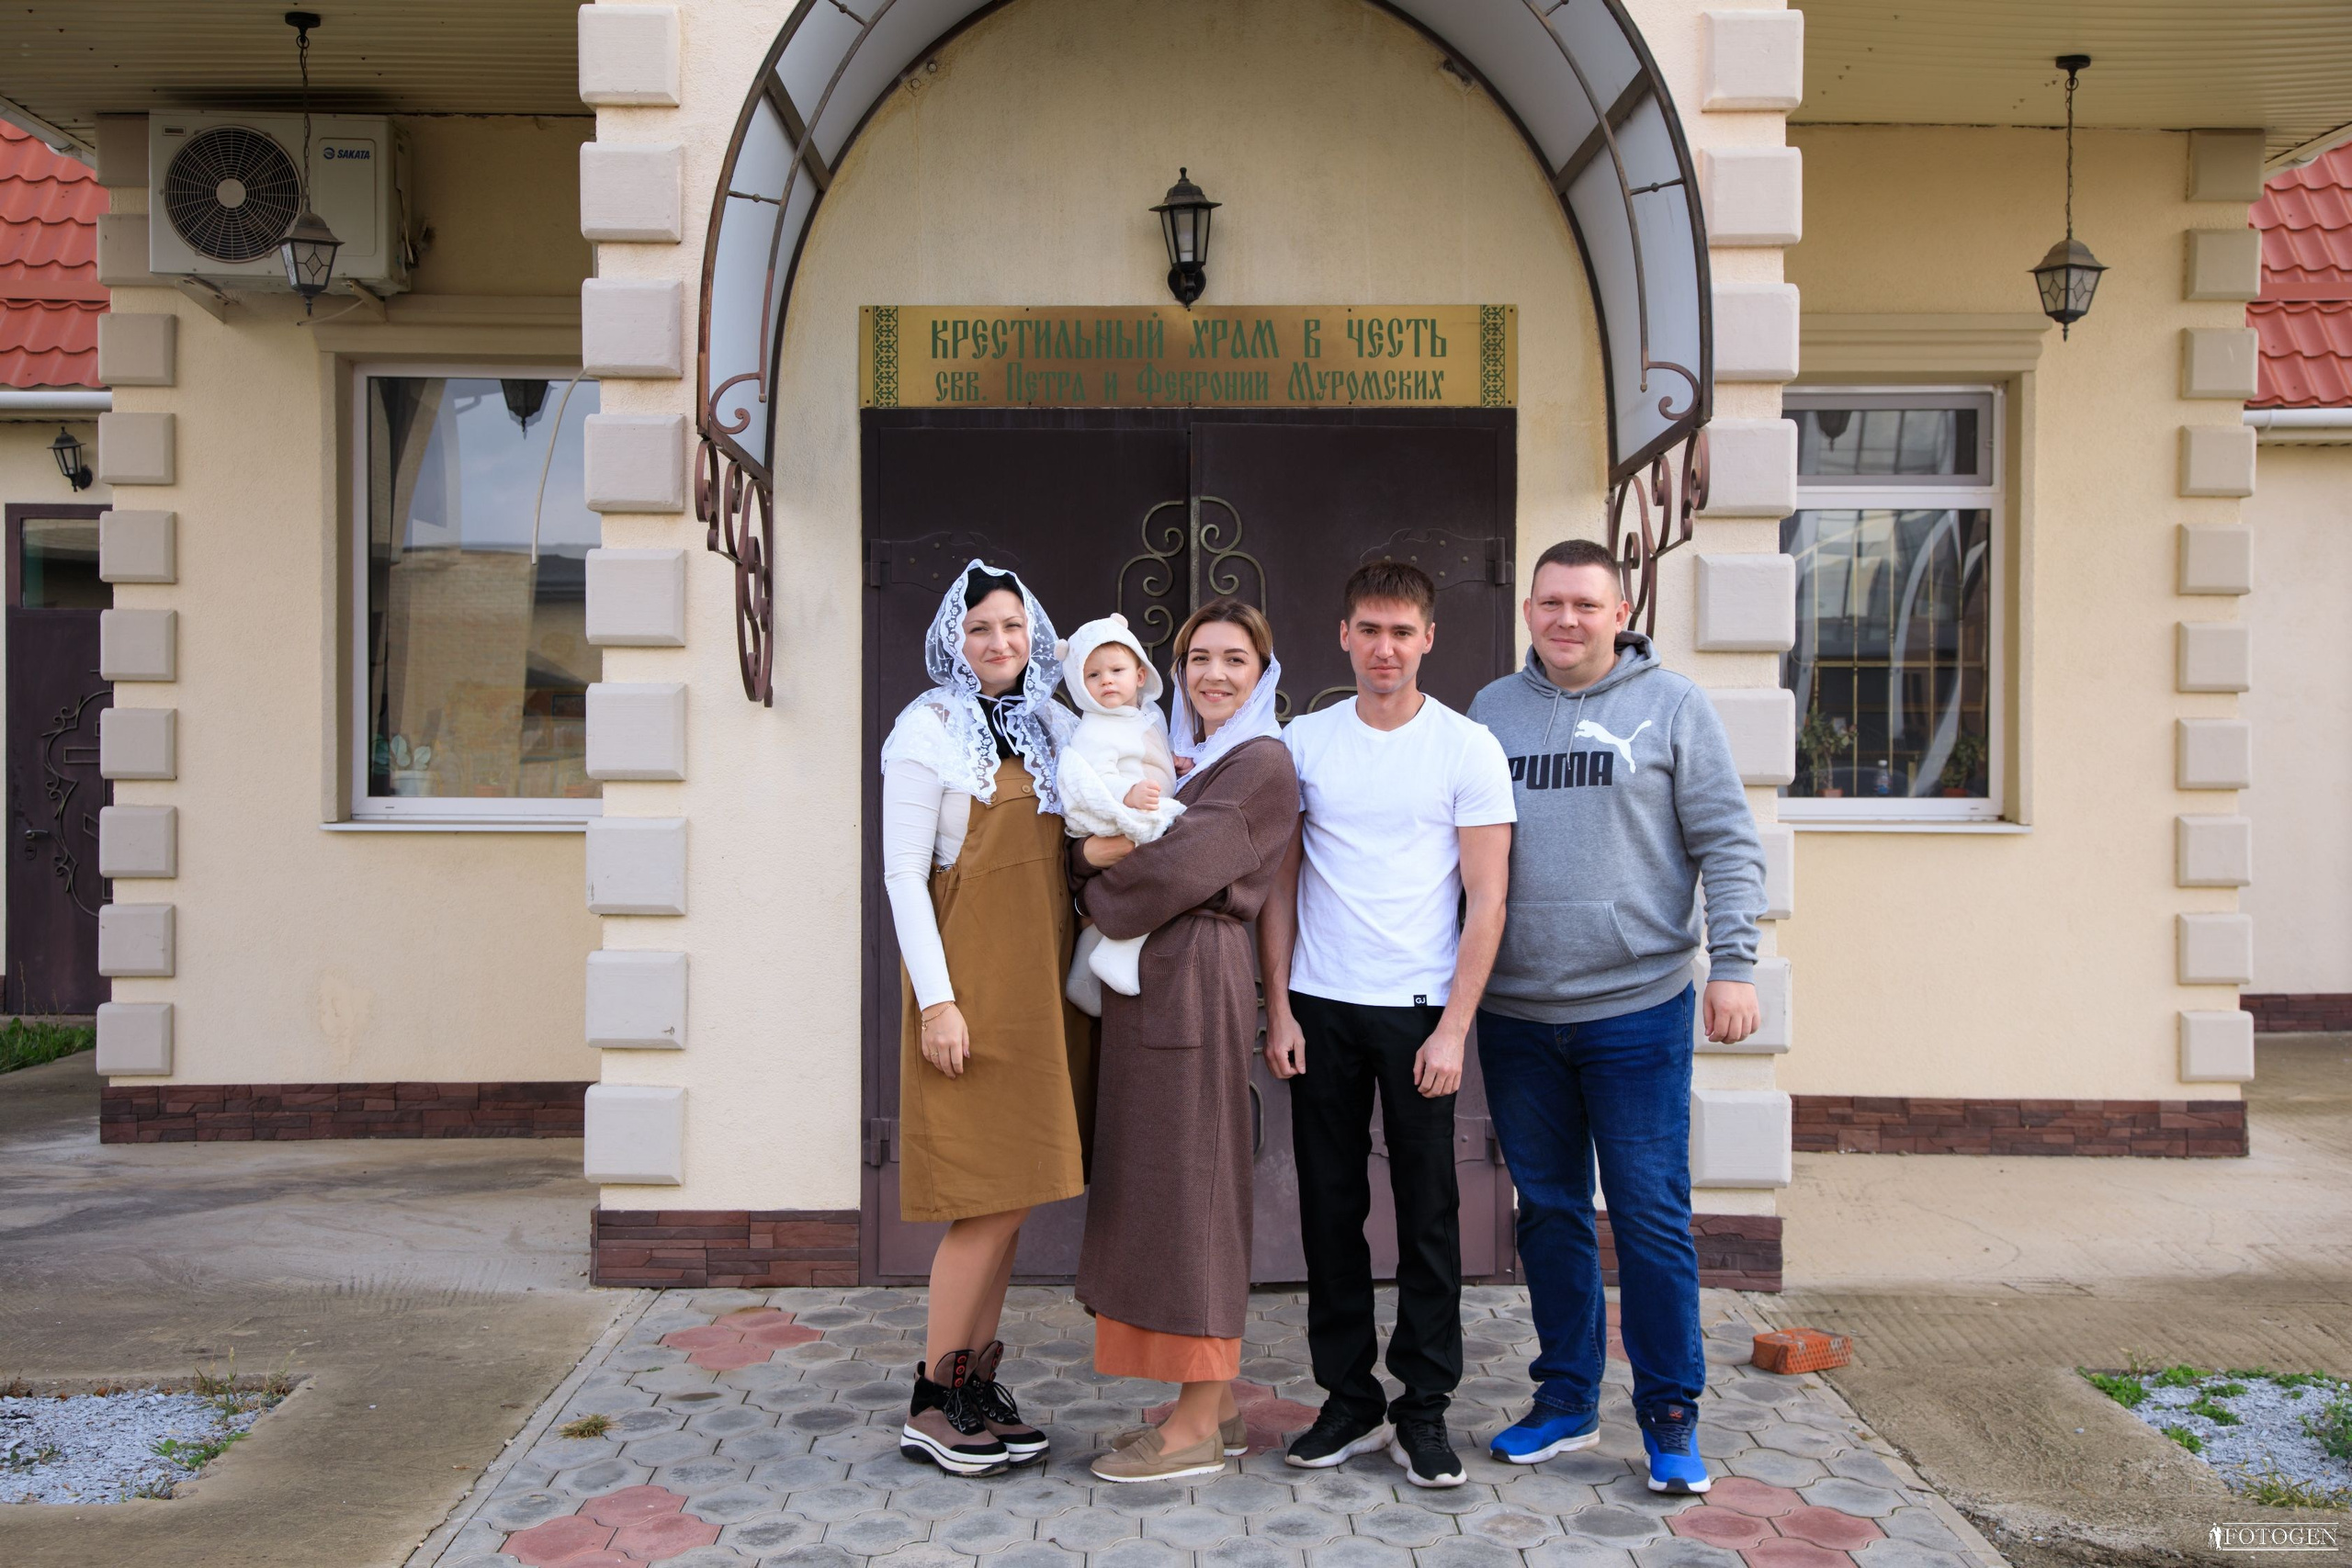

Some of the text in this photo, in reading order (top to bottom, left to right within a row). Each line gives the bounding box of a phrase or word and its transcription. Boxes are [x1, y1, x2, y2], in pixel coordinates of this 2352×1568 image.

[337, 149, 370, 160] SAKATA
[931, 311, 1447, 359] КРЕСТИЛЬНЫЙ ХРАМ В ЧЕСТЬ
[1508, 750, 1614, 790] PUMA
